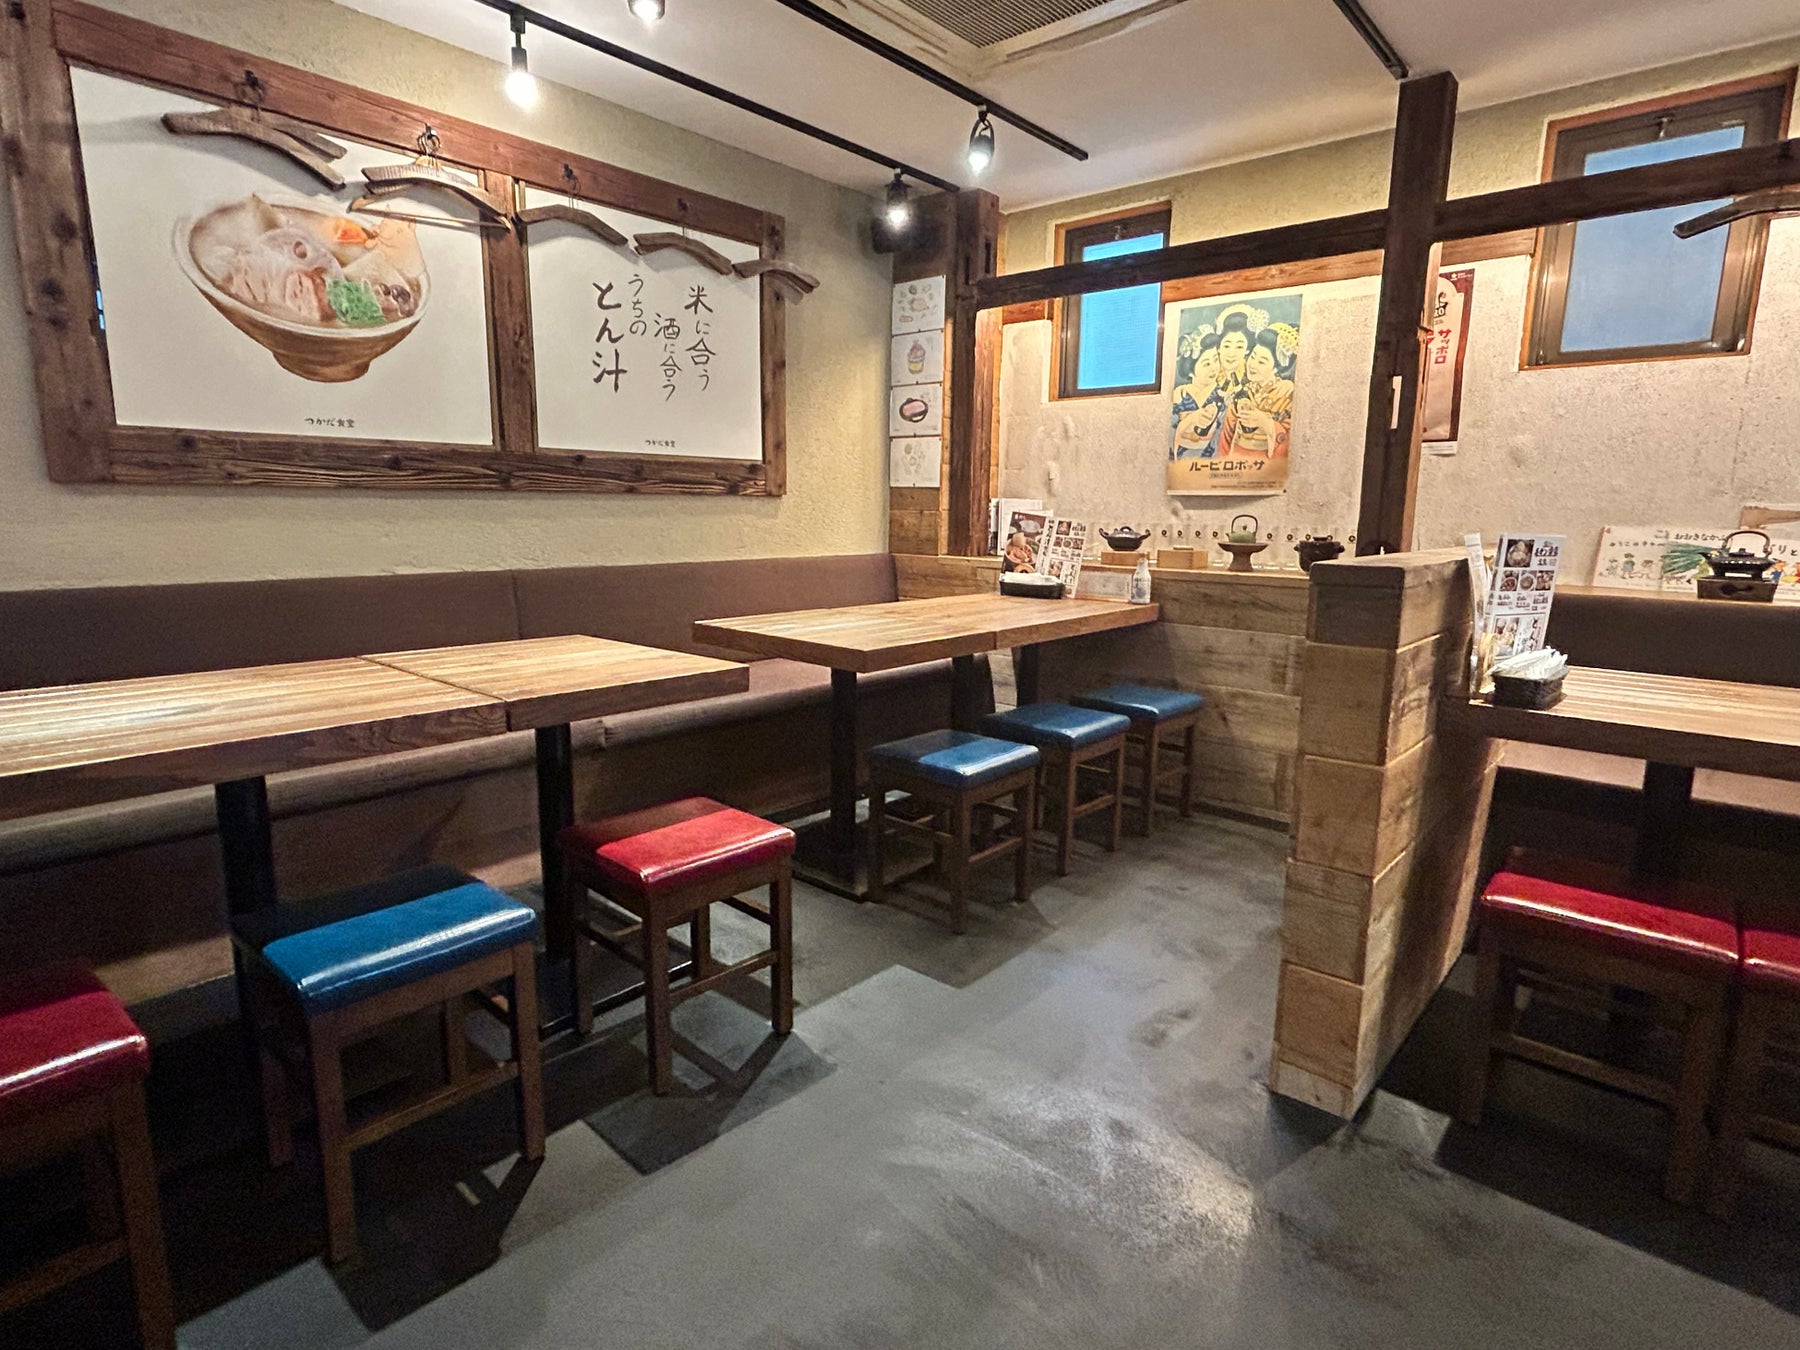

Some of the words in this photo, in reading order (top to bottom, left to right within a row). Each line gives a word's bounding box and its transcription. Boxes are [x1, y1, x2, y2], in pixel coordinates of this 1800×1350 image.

[592, 281, 628, 393] とん汁
[628, 273, 648, 337] うちの
[684, 285, 716, 391] 米に合う
[1434, 329, 1451, 364] サッポロ
[654, 312, 682, 401] 酒に合う
